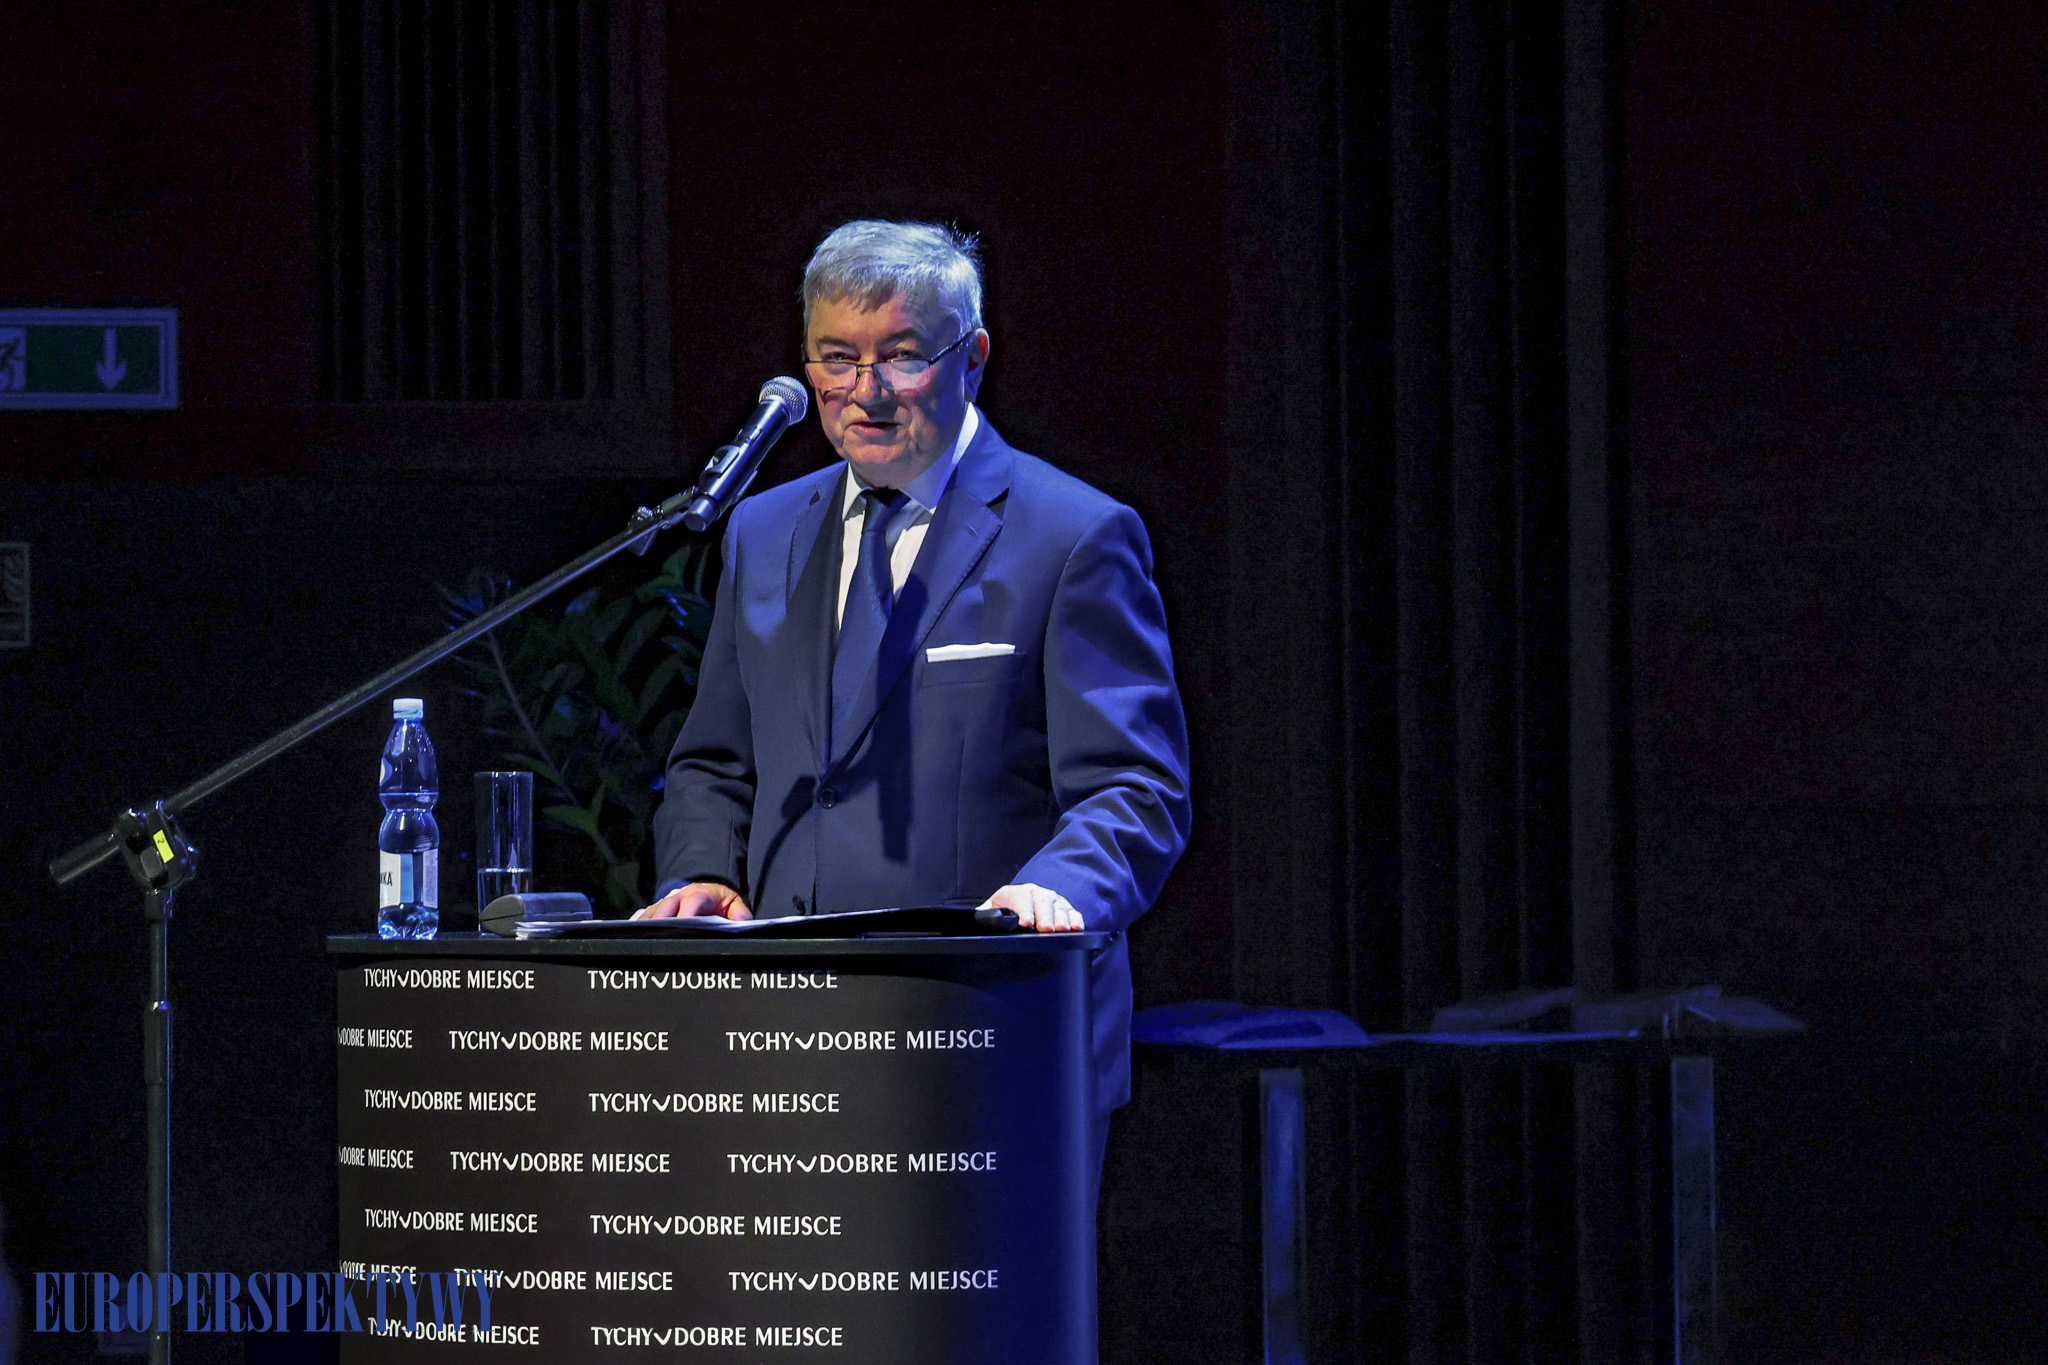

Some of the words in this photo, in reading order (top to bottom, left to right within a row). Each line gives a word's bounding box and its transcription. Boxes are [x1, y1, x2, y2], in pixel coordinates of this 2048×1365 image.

[364, 968, 397, 988] TYCHY
[411, 969, 461, 989] DOBRE
[467, 969, 535, 989] MIEJSCE
[587, 969, 650, 990] TYCHY
[672, 970, 742, 990] DOBRE
[751, 971, 838, 990] MIEJSCE
[367, 1028, 413, 1049] MIEJSCE
[449, 1030, 500, 1051] TYCHY
[519, 1031, 582, 1051] DOBRE
[590, 1031, 669, 1051] MIEJSCE
[726, 1031, 795, 1051] TYCHY
[818, 1031, 896, 1051] DOBRE
[906, 1029, 995, 1050] MIEJSCE
[364, 1088, 399, 1109] TYCHY
[412, 1090, 463, 1111] DOBRE
[469, 1091, 537, 1112] MIEJSCE
[588, 1093, 652, 1113] TYCHY
[673, 1093, 743, 1113] DOBRE
[752, 1093, 840, 1113] MIEJSCE
[367, 1148, 414, 1169] MIEJSCE
[450, 1151, 502, 1171] TYCHY
[520, 1152, 584, 1173] DOBRE
[592, 1153, 670, 1173] MIEJSCE
[727, 1153, 796, 1174] TYCHY
[820, 1153, 898, 1173] DOBRE
[908, 1151, 997, 1173] MIEJSCE
[364, 1208, 400, 1229] TYCHY
[412, 1210, 464, 1232] DOBRE
[470, 1212, 538, 1233] MIEJSCE
[590, 1214, 653, 1235] TYCHY
[674, 1215, 745, 1236] DOBRE
[754, 1215, 842, 1236] MIEJSCE
[523, 1270, 587, 1291] DOBRE
[595, 1271, 673, 1291] MIEJSCE
[728, 1271, 797, 1291] TYCHY
[821, 1271, 899, 1291] DOBRE
[910, 1269, 998, 1291] MIEJSCE
[591, 1326, 653, 1347] TYCHY
[675, 1326, 746, 1347] DOBRE
[756, 1326, 843, 1347] MIEJSCE
